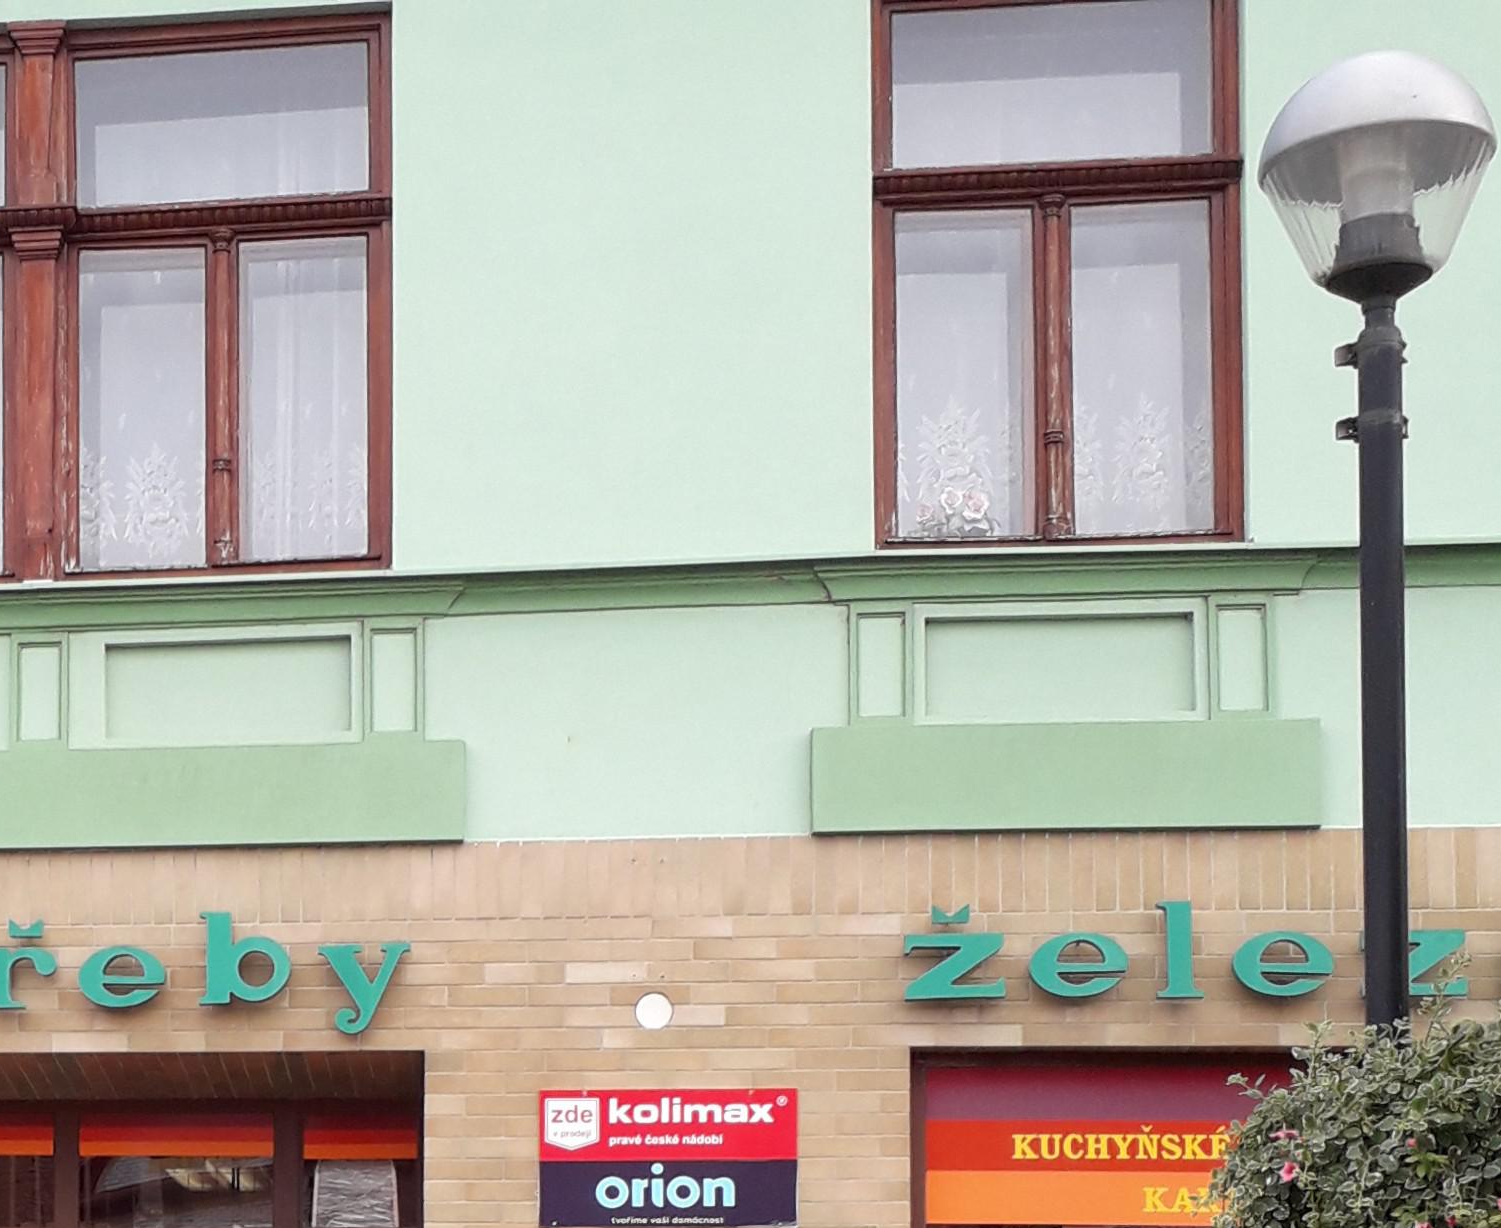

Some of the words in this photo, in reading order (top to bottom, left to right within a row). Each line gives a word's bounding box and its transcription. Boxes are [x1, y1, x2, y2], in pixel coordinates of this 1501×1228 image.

[551, 1105, 593, 1124] zde
[608, 1097, 774, 1124] kolimax
[608, 1134, 642, 1147] pravé
[645, 1133, 679, 1145] české
[682, 1133, 723, 1145] nádobí
[1012, 1124, 1231, 1161] KUCHYŇSKÉ
[595, 1163, 736, 1208] orion
